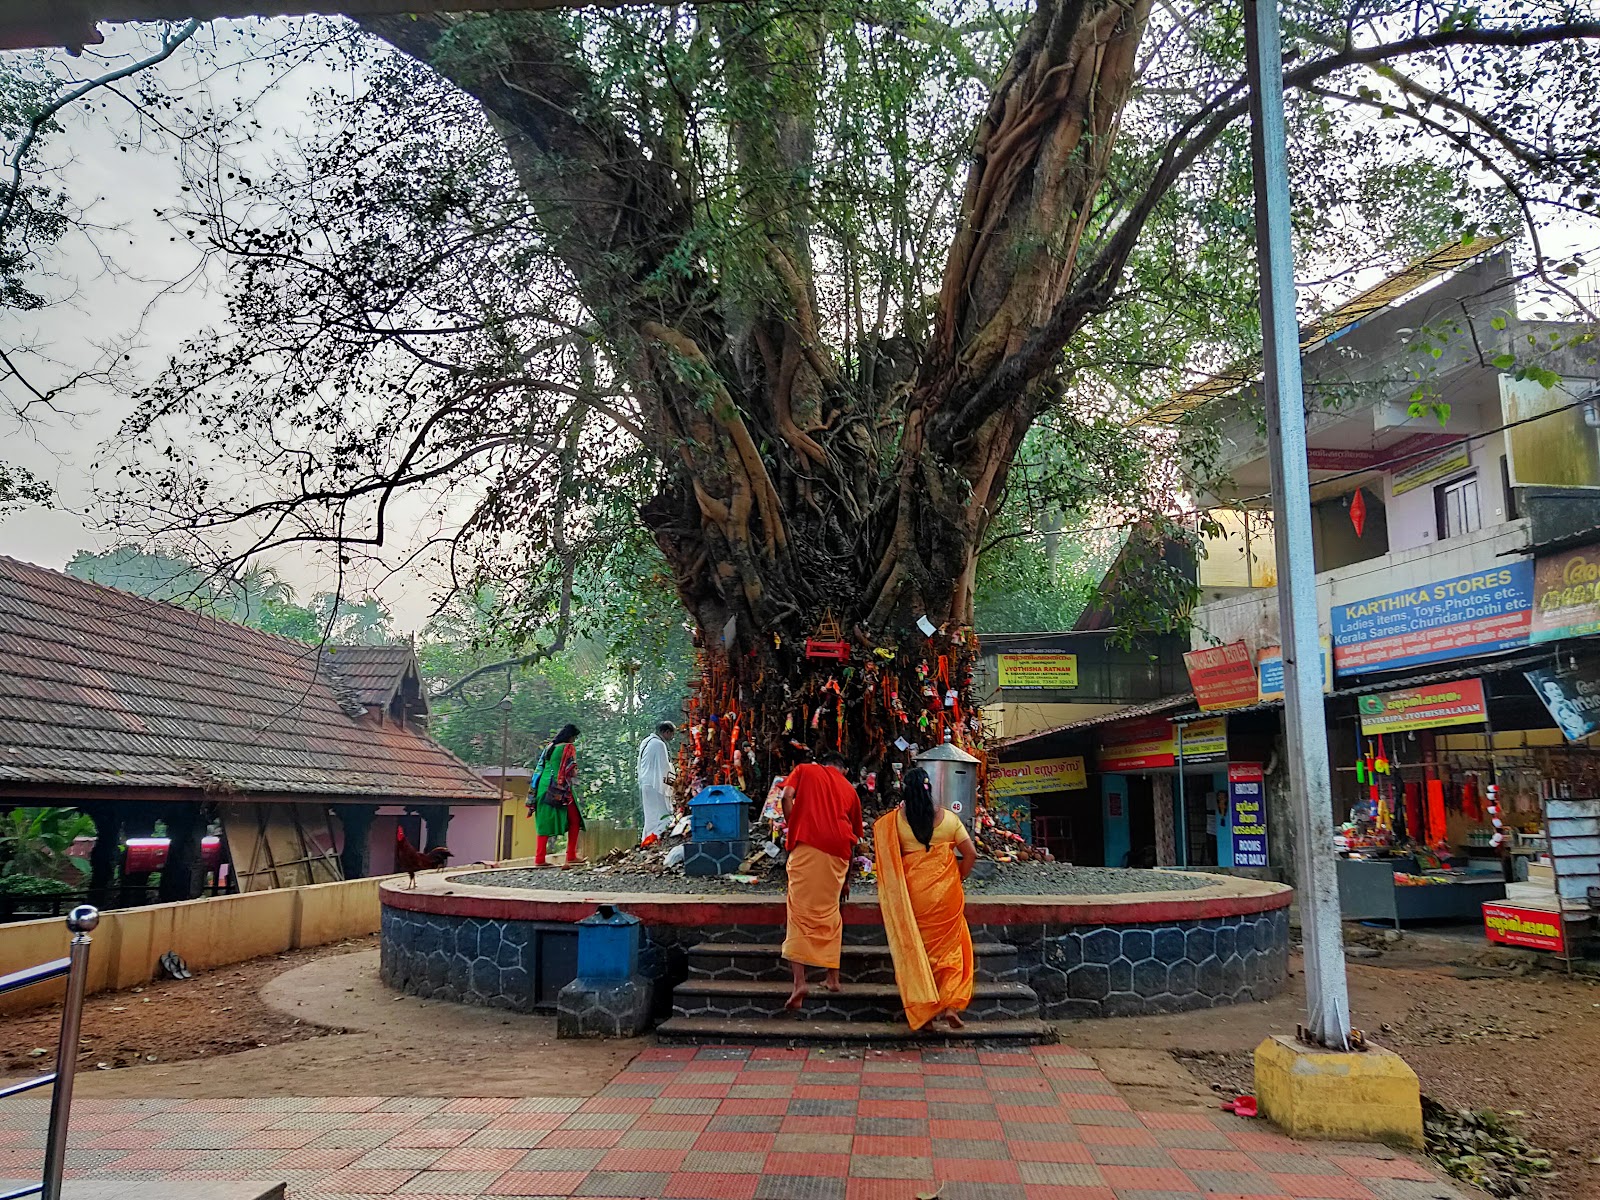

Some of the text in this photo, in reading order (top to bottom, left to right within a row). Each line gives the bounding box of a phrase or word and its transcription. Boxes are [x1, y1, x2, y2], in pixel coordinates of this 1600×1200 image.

[1345, 569, 1513, 620] KARTHIKA STORES
[1340, 618, 1375, 633] Ladies
[1377, 611, 1411, 626] items,
[1334, 631, 1368, 646] Kerala
[1362, 714, 1404, 726] DEVIKRIPA
[1404, 703, 1481, 720] JYOTHISHALAYAM
[952, 803, 961, 811] 48
[1239, 839, 1262, 852] ROOMS
[1235, 853, 1267, 865] FOR DAILY
